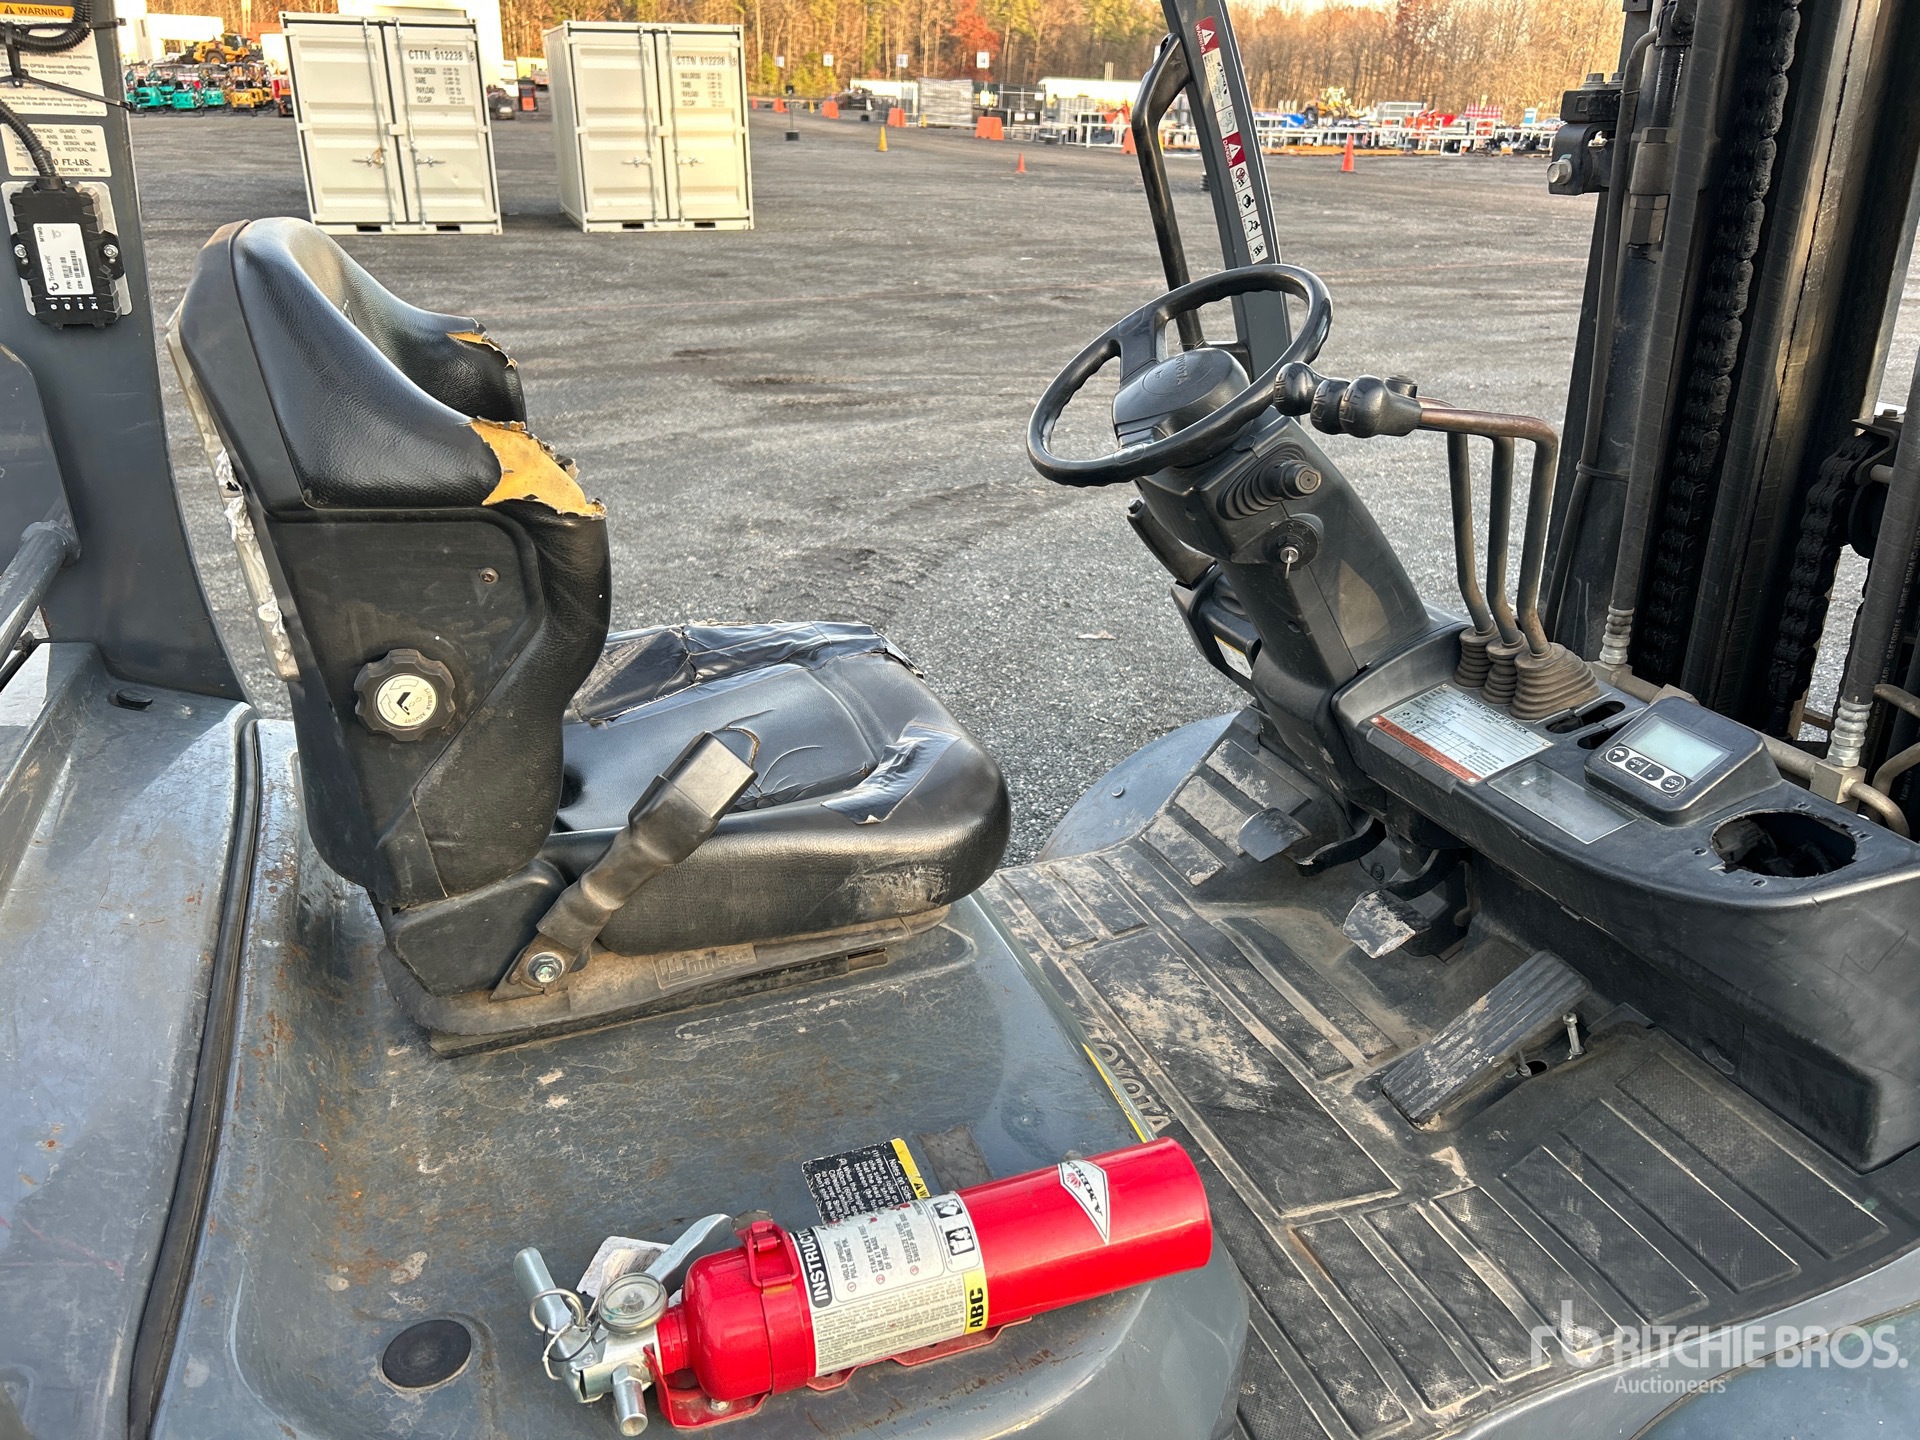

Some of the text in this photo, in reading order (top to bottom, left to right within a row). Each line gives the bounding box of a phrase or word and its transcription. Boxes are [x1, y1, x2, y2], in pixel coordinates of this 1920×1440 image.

[18, 6, 64, 16] WARNING
[1196, 24, 1206, 53] WARNING
[408, 50, 430, 60] CTTN
[676, 56, 696, 65] CTTN
[1222, 140, 1232, 166] DANGER
[44, 255, 55, 282] Trackunit
[1461, 694, 1481, 708] TOYOTA
[1481, 706, 1508, 722] FORKLIFT
[1509, 721, 1529, 734] TRUCK
[1088, 1026, 1172, 1134] TOYOTA
[854, 1163, 869, 1187] between
[862, 1161, 871, 1173] that
[889, 1159, 901, 1176] Notes
[897, 1176, 905, 1186] on
[814, 1173, 824, 1189] Don't
[820, 1188, 829, 1201] shift
[842, 1166, 853, 1182] When
[853, 1192, 866, 1210] height
[876, 1158, 886, 1174] When
[885, 1180, 895, 1194] load
[893, 1195, 899, 1203] on
[881, 1187, 890, 1200] shift
[833, 1200, 842, 1213] Shift
[838, 1194, 852, 1215] shifting
[864, 1239, 873, 1253] BACK
[871, 1236, 880, 1249] BASE
[901, 1239, 913, 1263] SQUEEZE
[910, 1242, 920, 1262] SWEEP
[869, 1254, 878, 1273] START
[875, 1249, 882, 1258] AT
[841, 1264, 850, 1280] HOLD
[849, 1262, 858, 1278] PULL
[885, 1261, 892, 1269] OF
[969, 1287, 984, 1328] ABC
